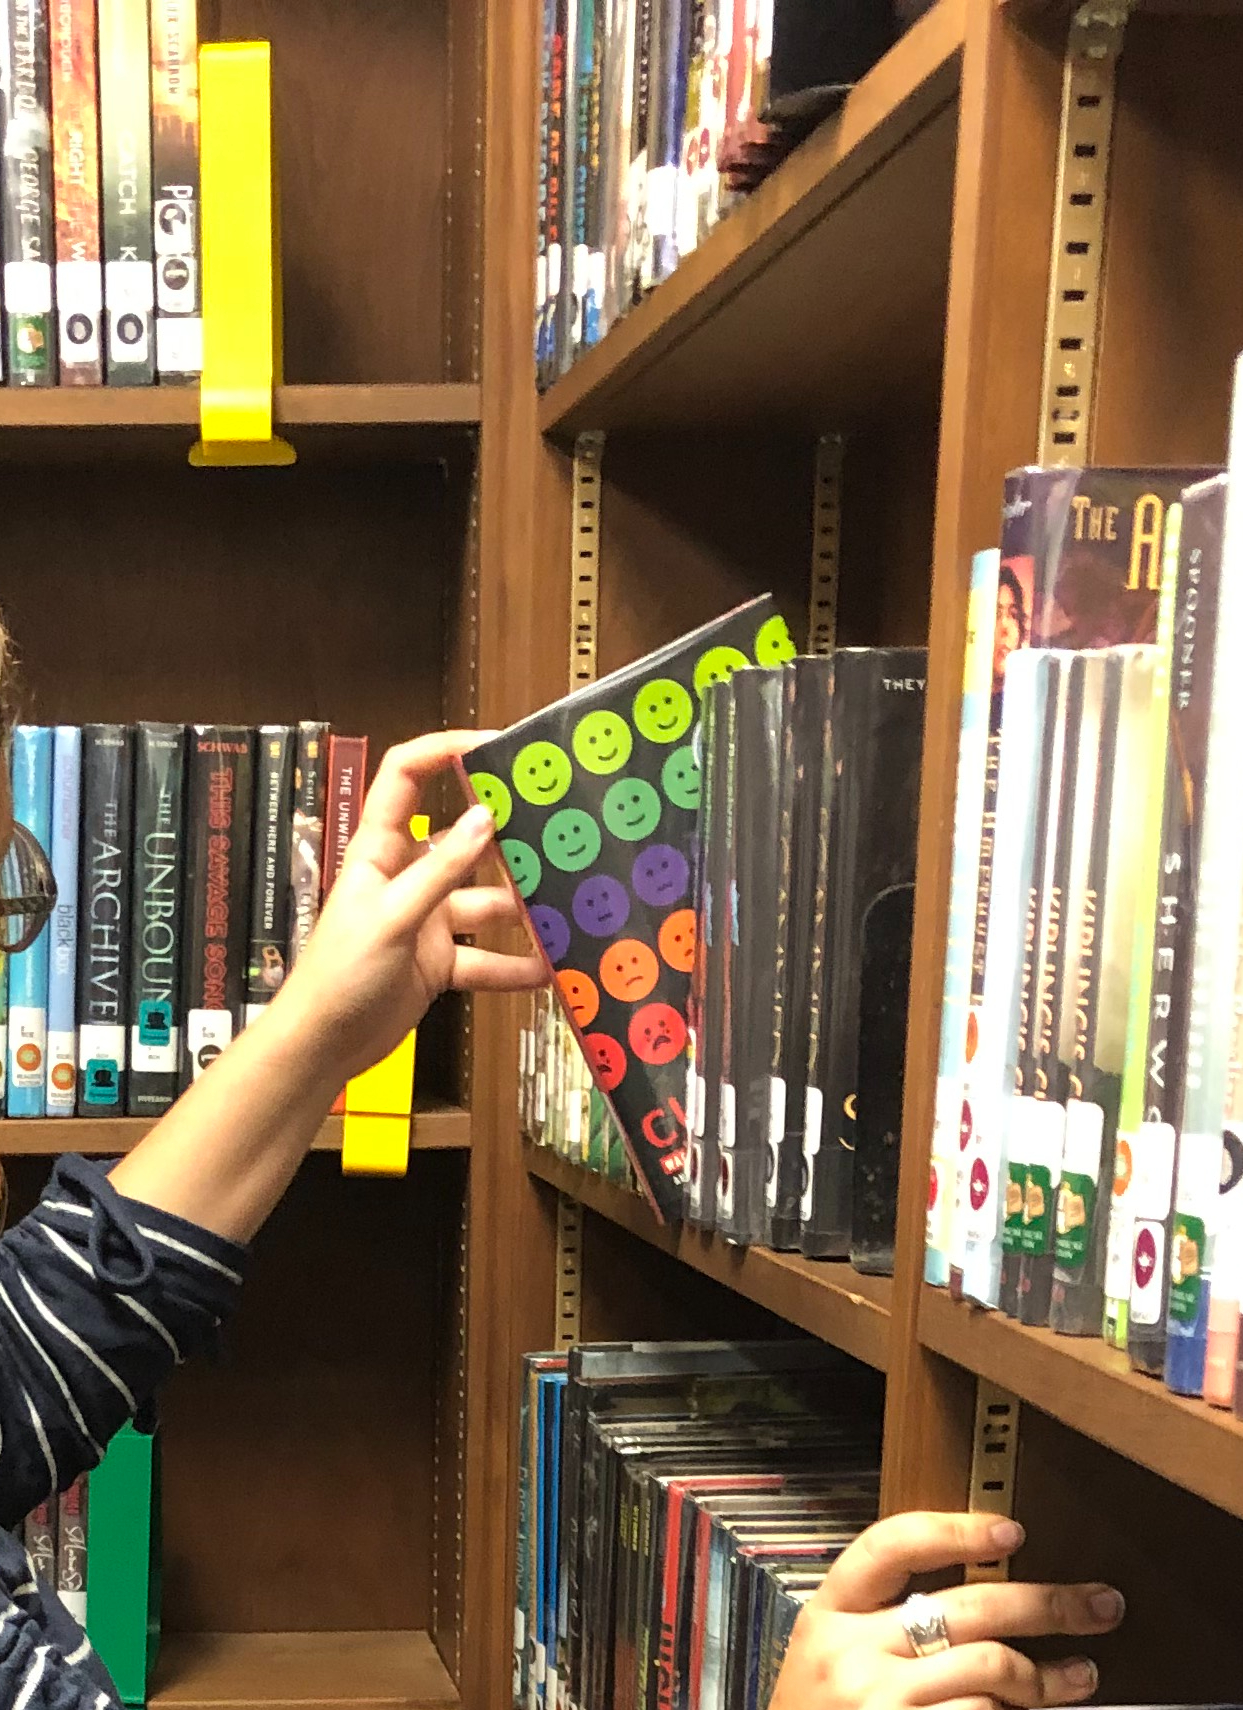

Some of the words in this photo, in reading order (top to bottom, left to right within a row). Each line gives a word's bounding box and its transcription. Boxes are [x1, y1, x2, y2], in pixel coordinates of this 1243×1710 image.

[13, 148, 40, 225] GEORGE
[116, 131, 138, 216] CATCH
[1072, 494, 1117, 542] THE
[1176, 548, 1204, 712] SPOONER
[882, 677, 927, 692] THEY
[197, 740, 248, 754] SCHWAB
[208, 765, 234, 831] THIS
[267, 772, 282, 824] BETWEEN
[337, 767, 354, 797] THE
[103, 801, 118, 838] THE
[157, 791, 173, 825] THE
[267, 825, 280, 854] HERE
[206, 834, 231, 938] SAVAGE
[266, 857, 278, 879] AND
[263, 881, 276, 931] FOREVER
[55, 903, 75, 976] blackbox
